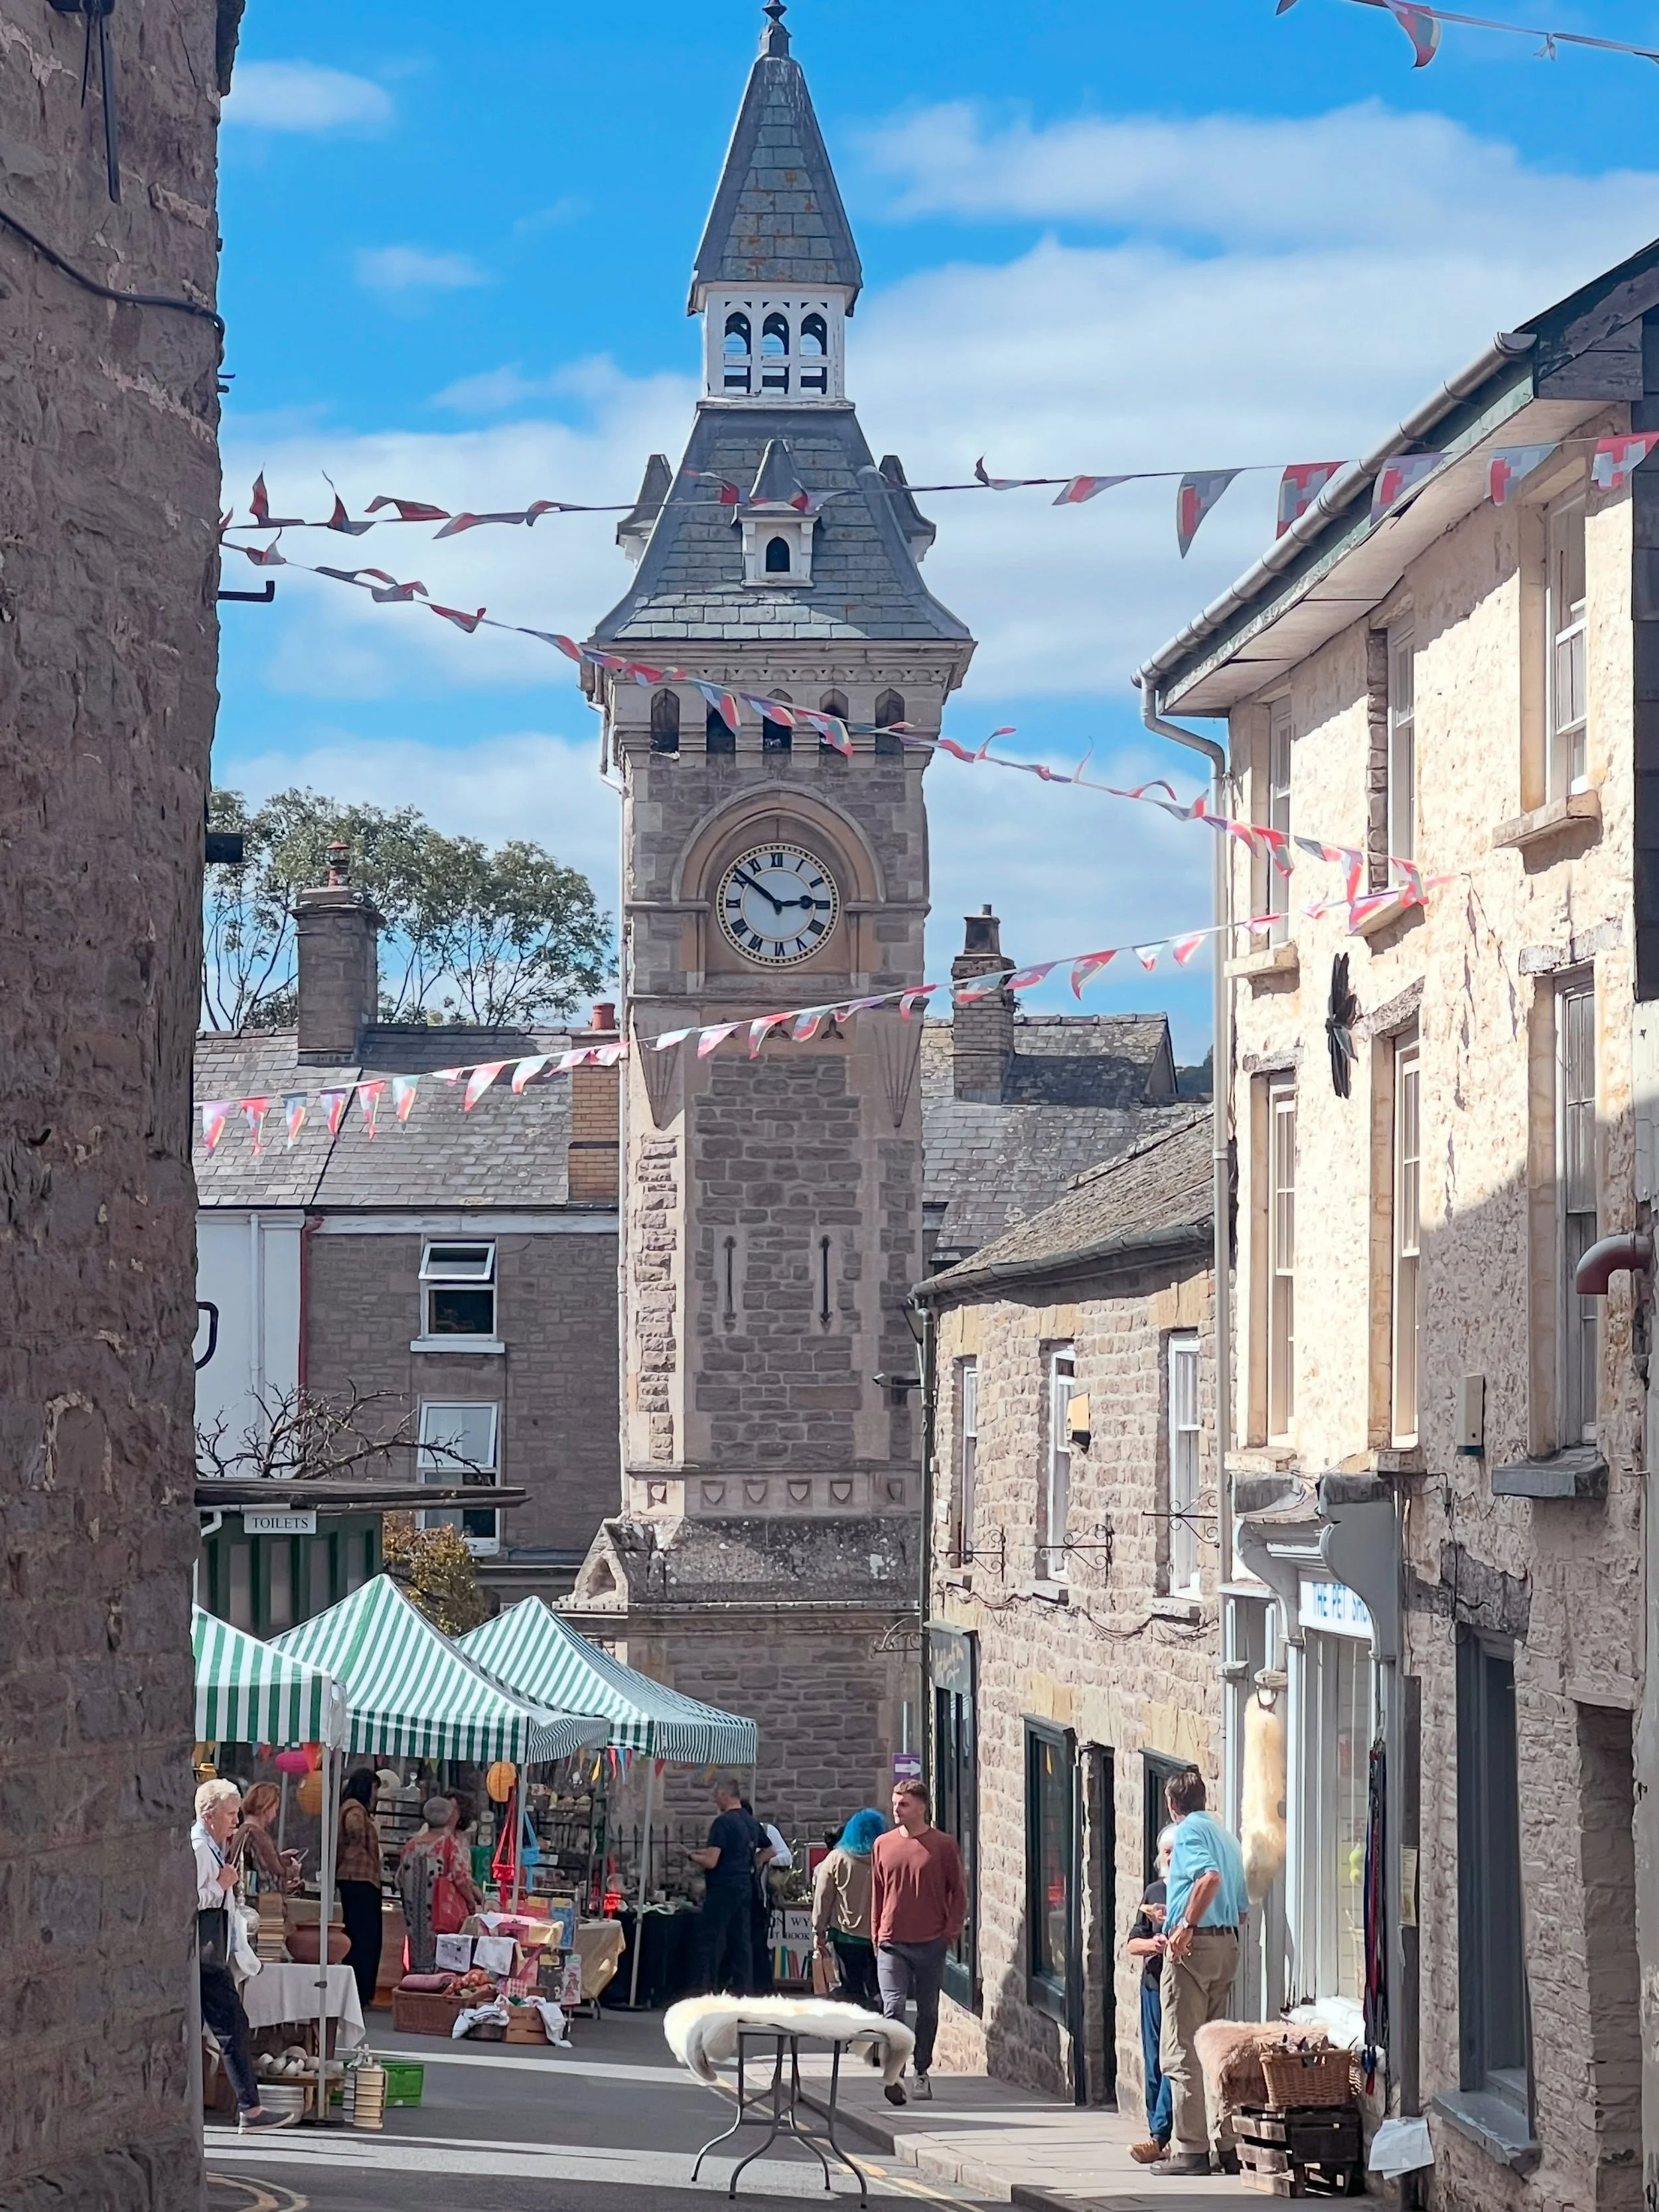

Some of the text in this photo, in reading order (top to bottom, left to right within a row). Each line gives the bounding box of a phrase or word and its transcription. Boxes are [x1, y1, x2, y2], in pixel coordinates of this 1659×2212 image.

[747, 857, 762, 875] XI
[770, 852, 783, 867] XII
[796, 859, 805, 872] I
[809, 876, 825, 888] II
[726, 899, 741, 908] IX
[815, 900, 830, 910] III
[730, 918, 749, 938] VIII
[747, 934, 763, 952] VII
[774, 941, 785, 956] VI
[796, 936, 808, 952] V
[252, 1517, 309, 1529] TOILETS
[1311, 1582, 1370, 1623] THE PET SHO
